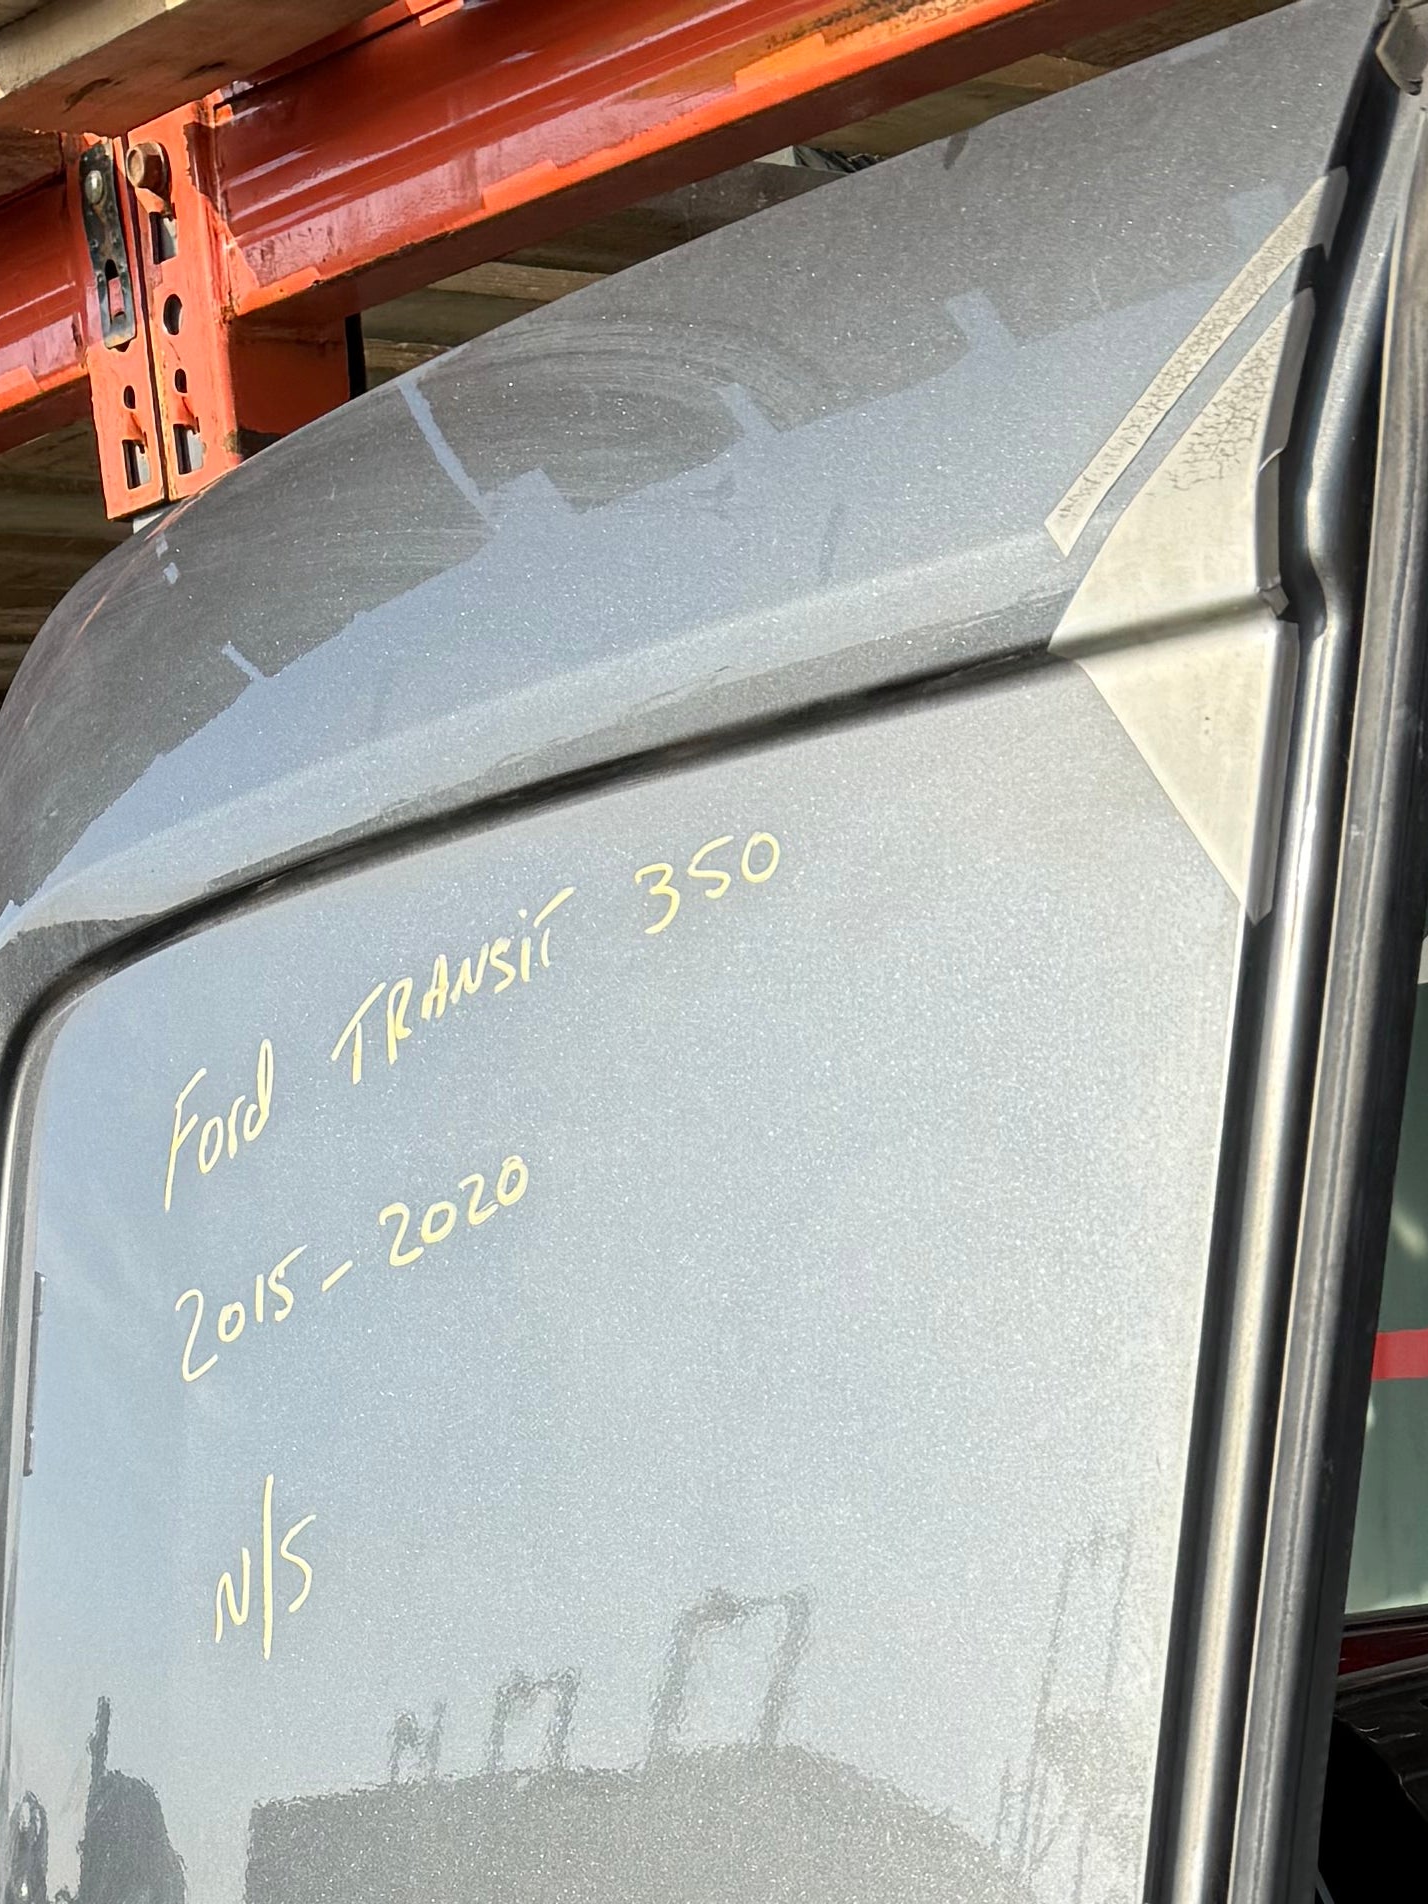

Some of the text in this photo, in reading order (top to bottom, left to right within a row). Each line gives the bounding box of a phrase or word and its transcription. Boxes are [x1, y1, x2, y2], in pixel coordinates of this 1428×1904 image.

[164, 1039, 274, 1212] Ford
[633, 832, 781, 935] 350
[214, 1475, 317, 1661] N/S
